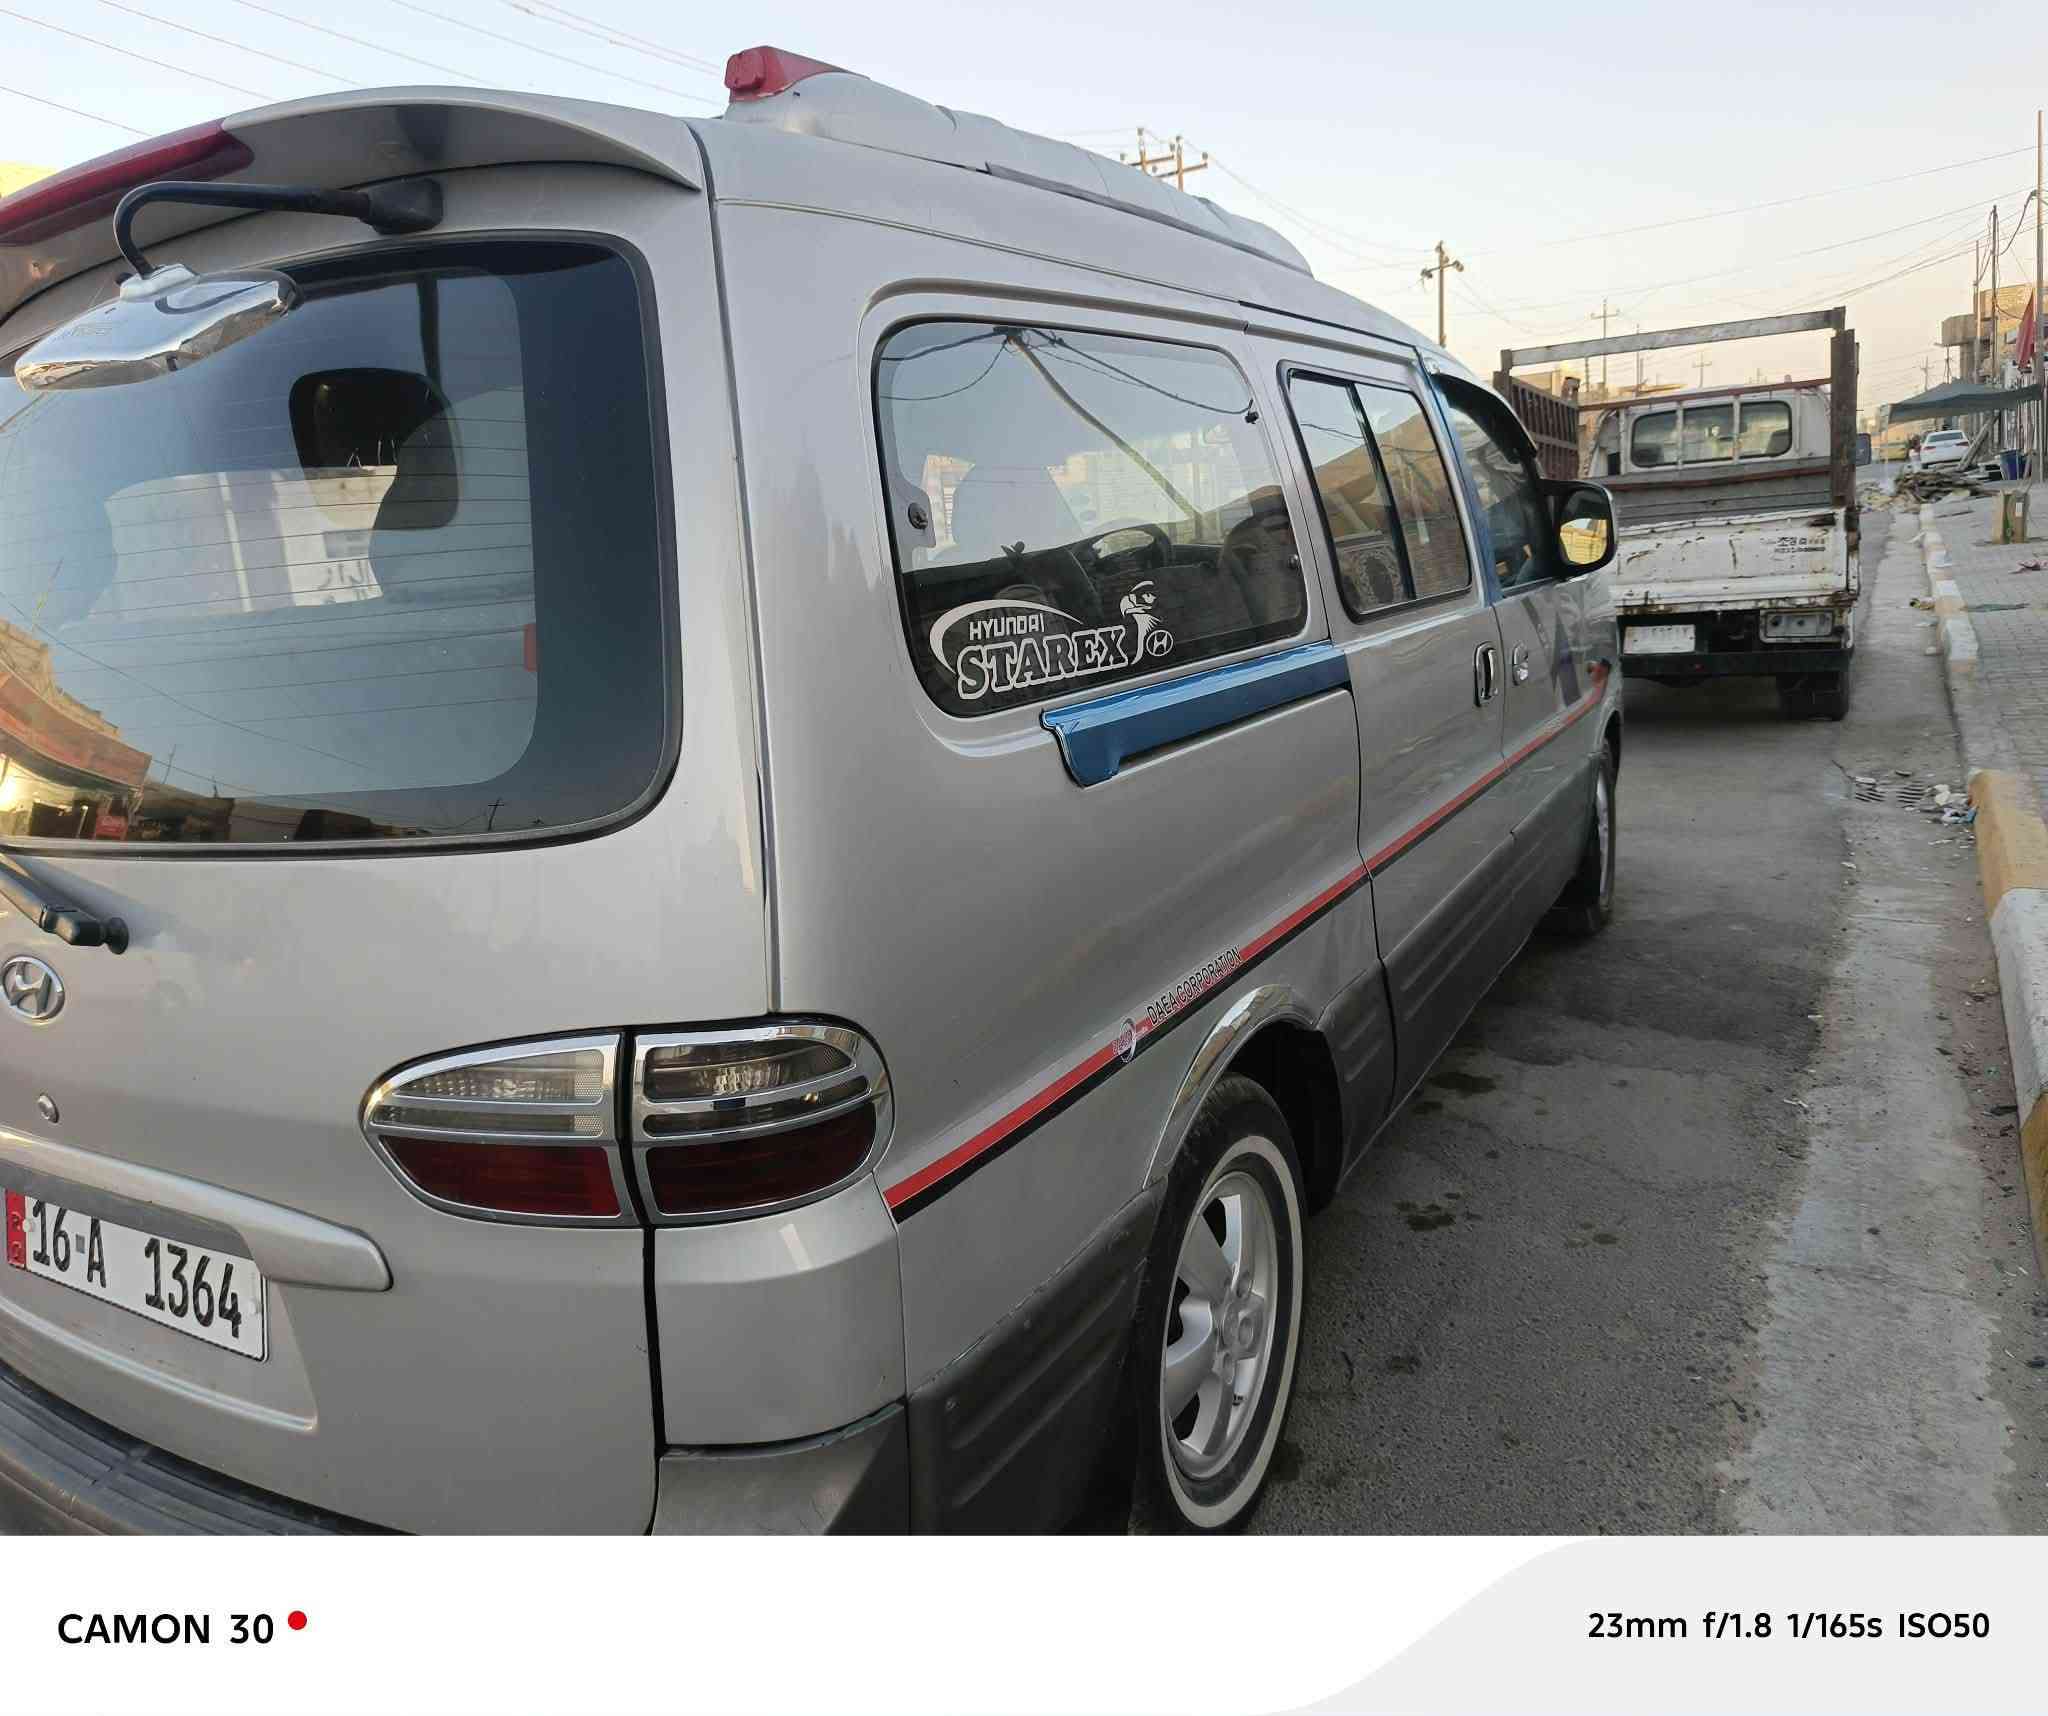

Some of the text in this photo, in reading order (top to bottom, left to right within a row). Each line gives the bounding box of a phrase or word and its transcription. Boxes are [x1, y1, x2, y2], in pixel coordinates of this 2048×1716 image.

[957, 625, 1129, 700] STAREX
[1146, 945, 1242, 1025] DAEA CORPORATION
[145, 1238, 242, 1339] 1364
